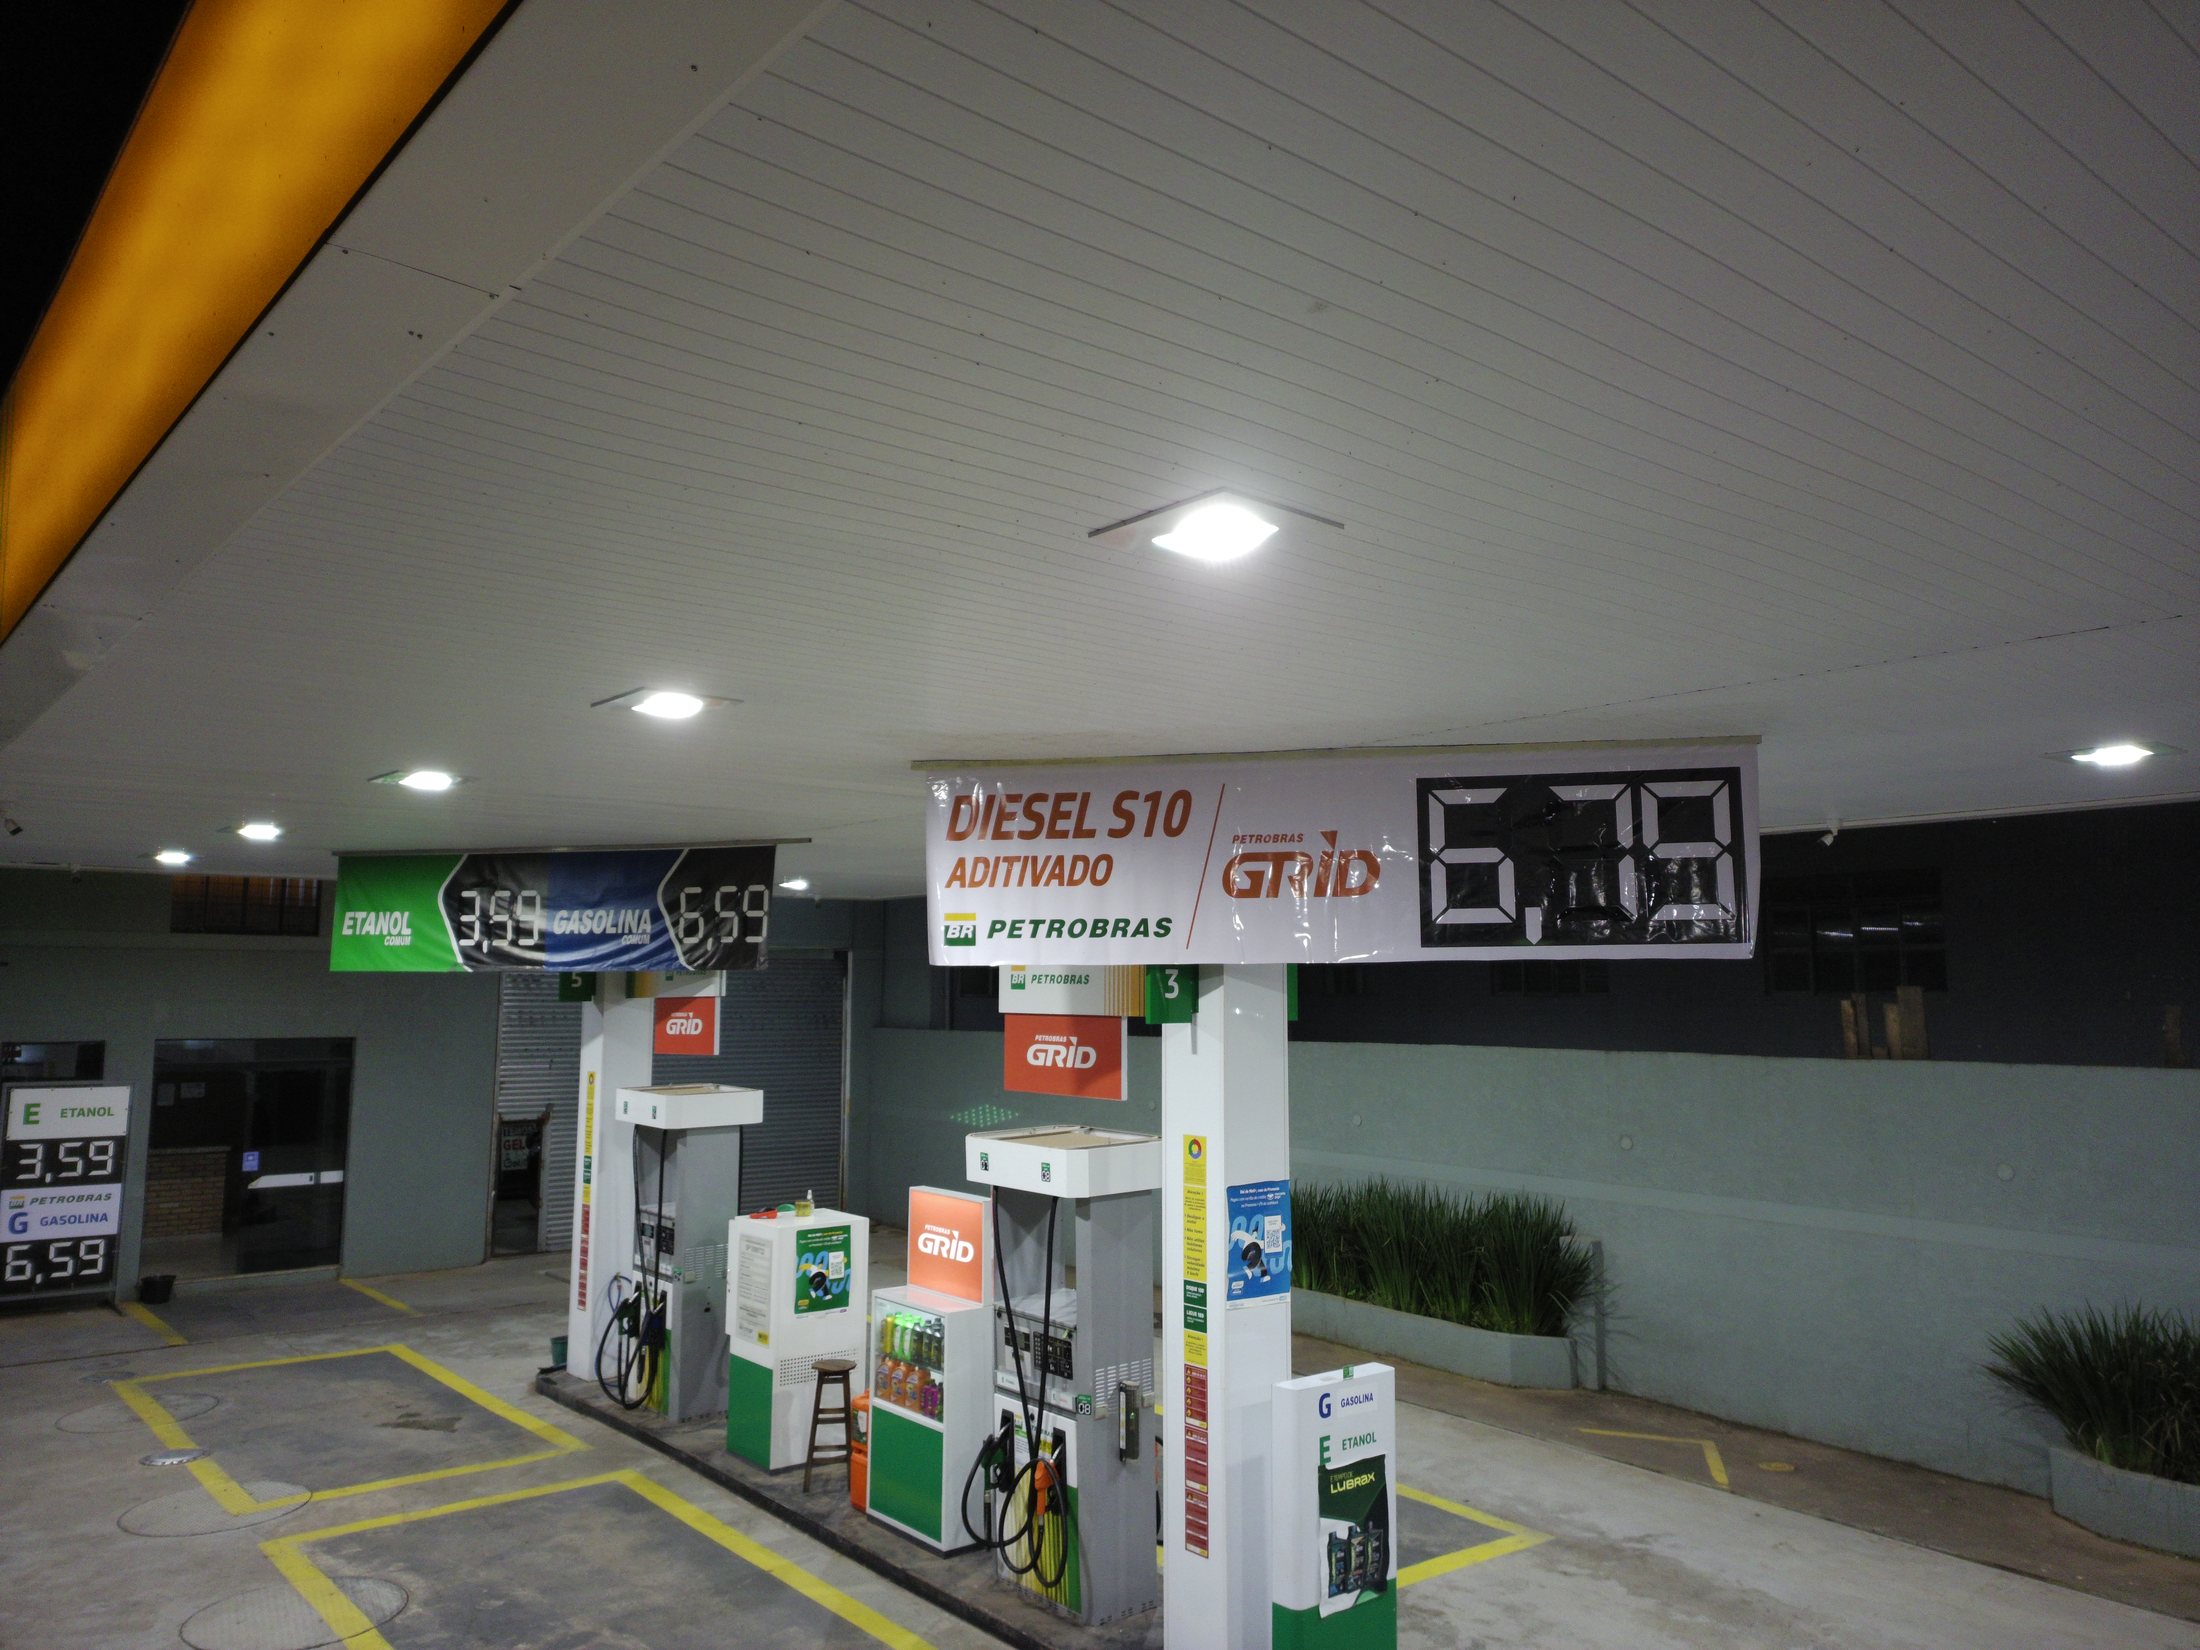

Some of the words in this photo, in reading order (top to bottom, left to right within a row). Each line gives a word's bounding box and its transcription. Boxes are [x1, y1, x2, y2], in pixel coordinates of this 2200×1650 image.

[945, 791, 1097, 842] DIESEL
[1107, 789, 1192, 839] S10
[1231, 831, 1304, 844] PETROBRAS
[944, 853, 1114, 888] ADITIVADO
[341, 910, 413, 936] ETANOL
[458, 890, 540, 954] 3,59
[552, 909, 652, 935] GASOLINA
[679, 884, 769, 951] 6,59
[986, 917, 1173, 940] PETROBRAS
[384, 935, 411, 946] COMUM
[621, 933, 650, 945] COMUM
[1030, 974, 1090, 985] PETROBRAS
[1164, 969, 1179, 999] 3
[22, 1103, 41, 1125] E
[60, 1106, 115, 1119] ETANOL
[16, 1140, 114, 1184] 3,59
[29, 1192, 112, 1206] PETROBRAS
[8, 1212, 28, 1235] G
[40, 1212, 108, 1226] GASOLINA
[5, 1239, 105, 1284] 6,59
[1078, 1402, 1090, 1414] 08
[1318, 1392, 1331, 1418] G
[1340, 1392, 1374, 1408] GASOLINA
[1320, 1434, 1331, 1465] E
[1342, 1432, 1377, 1451] ETANOL
